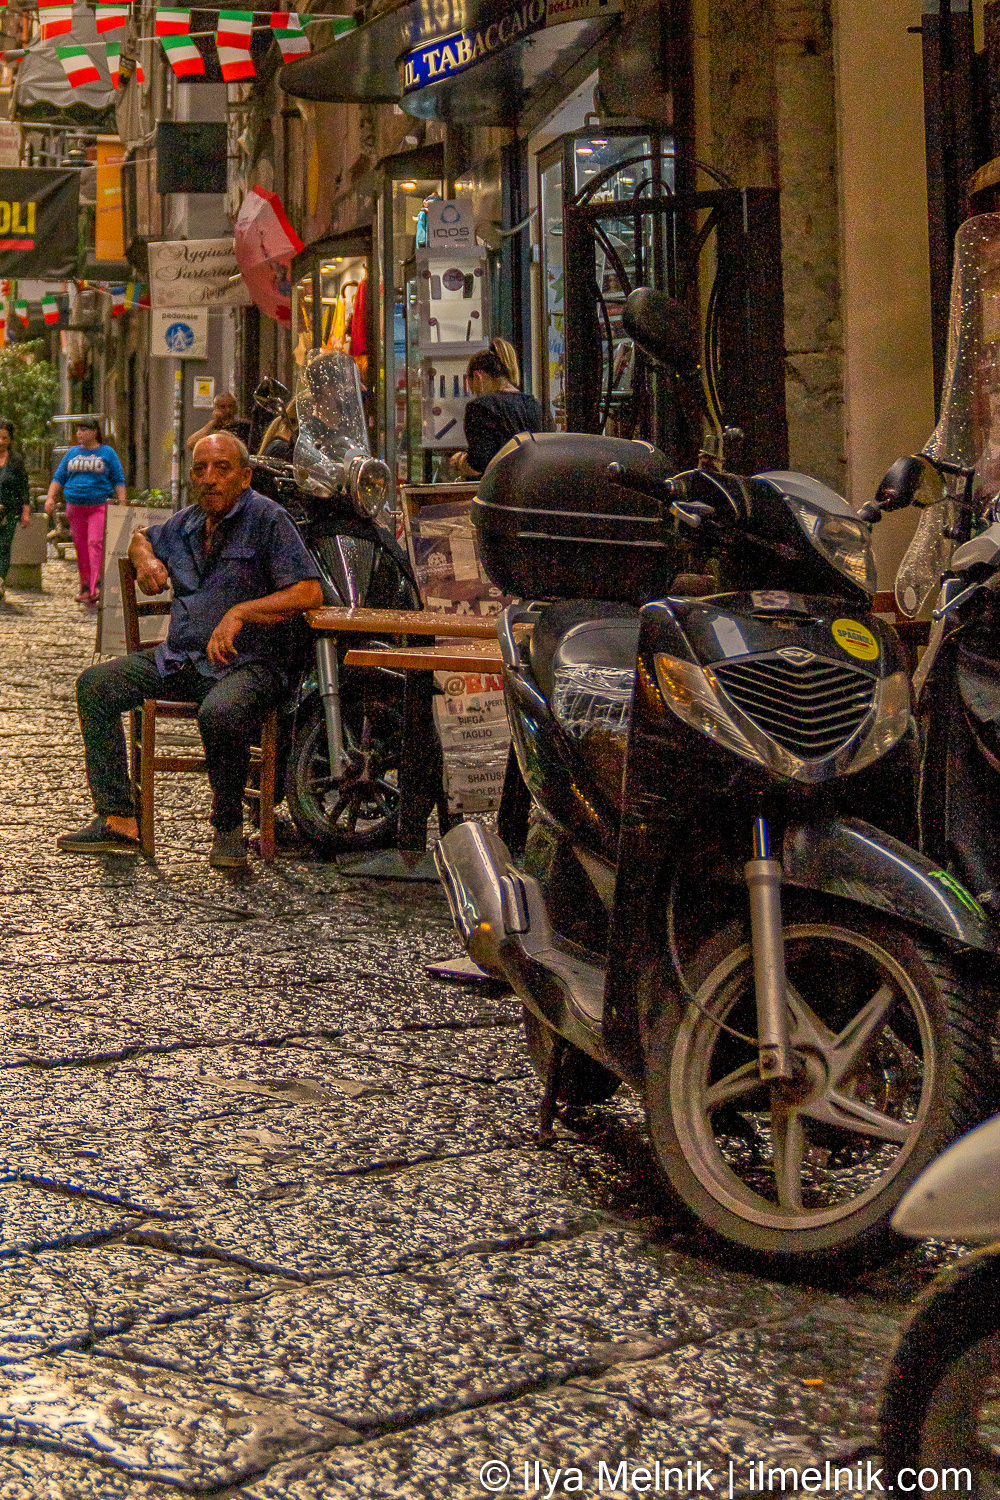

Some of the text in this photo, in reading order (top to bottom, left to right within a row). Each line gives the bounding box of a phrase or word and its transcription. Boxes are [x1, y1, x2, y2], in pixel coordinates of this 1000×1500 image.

[405, 60, 420, 87] IL
[433, 226, 470, 239] IQOS
[161, 312, 199, 321] pedonale
[461, 729, 492, 740] TAGLIO
